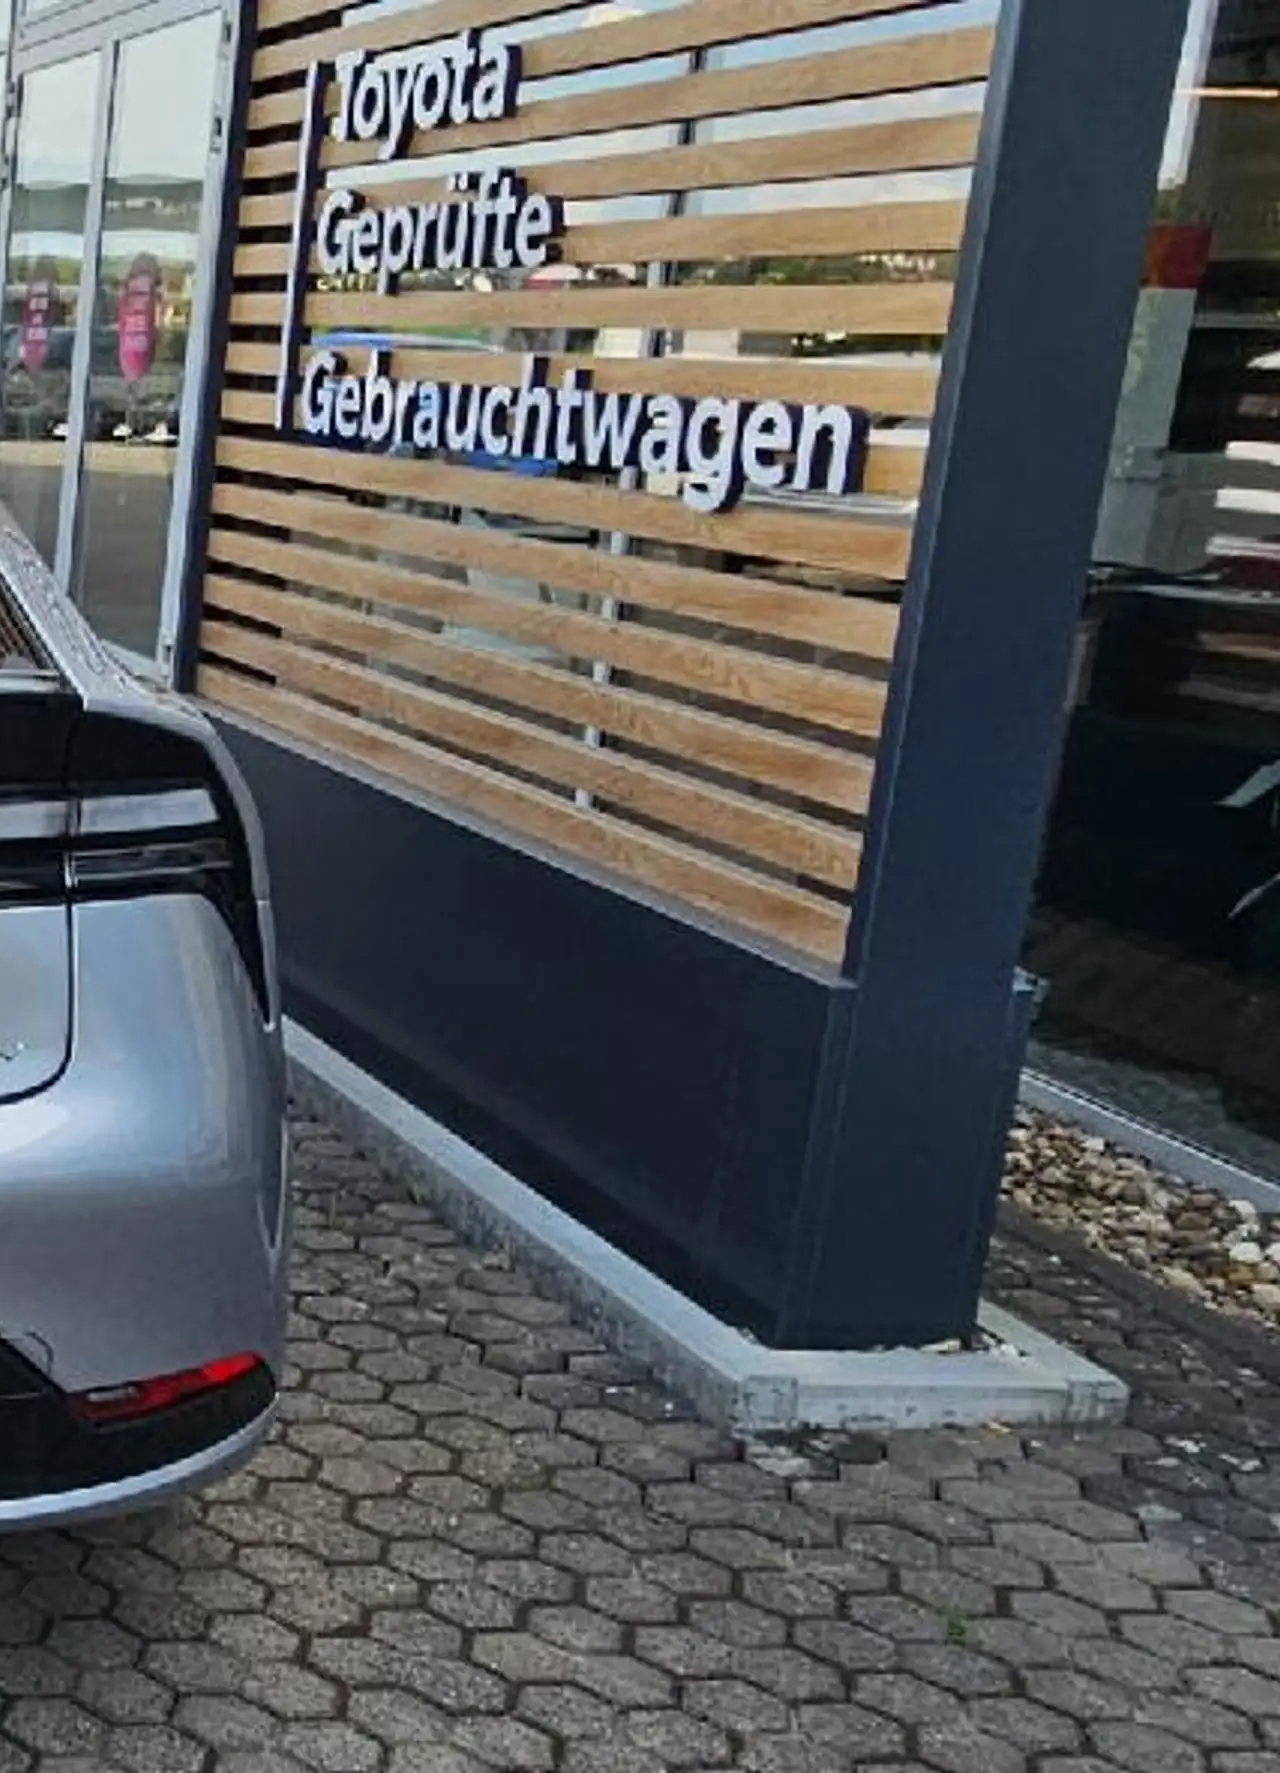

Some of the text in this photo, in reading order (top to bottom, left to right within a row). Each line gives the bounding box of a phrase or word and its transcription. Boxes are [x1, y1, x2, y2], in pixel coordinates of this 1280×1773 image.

[334, 28, 511, 160] Toyota
[317, 170, 553, 295] Geprüfte
[301, 352, 854, 513] Gebrauchtwagen
